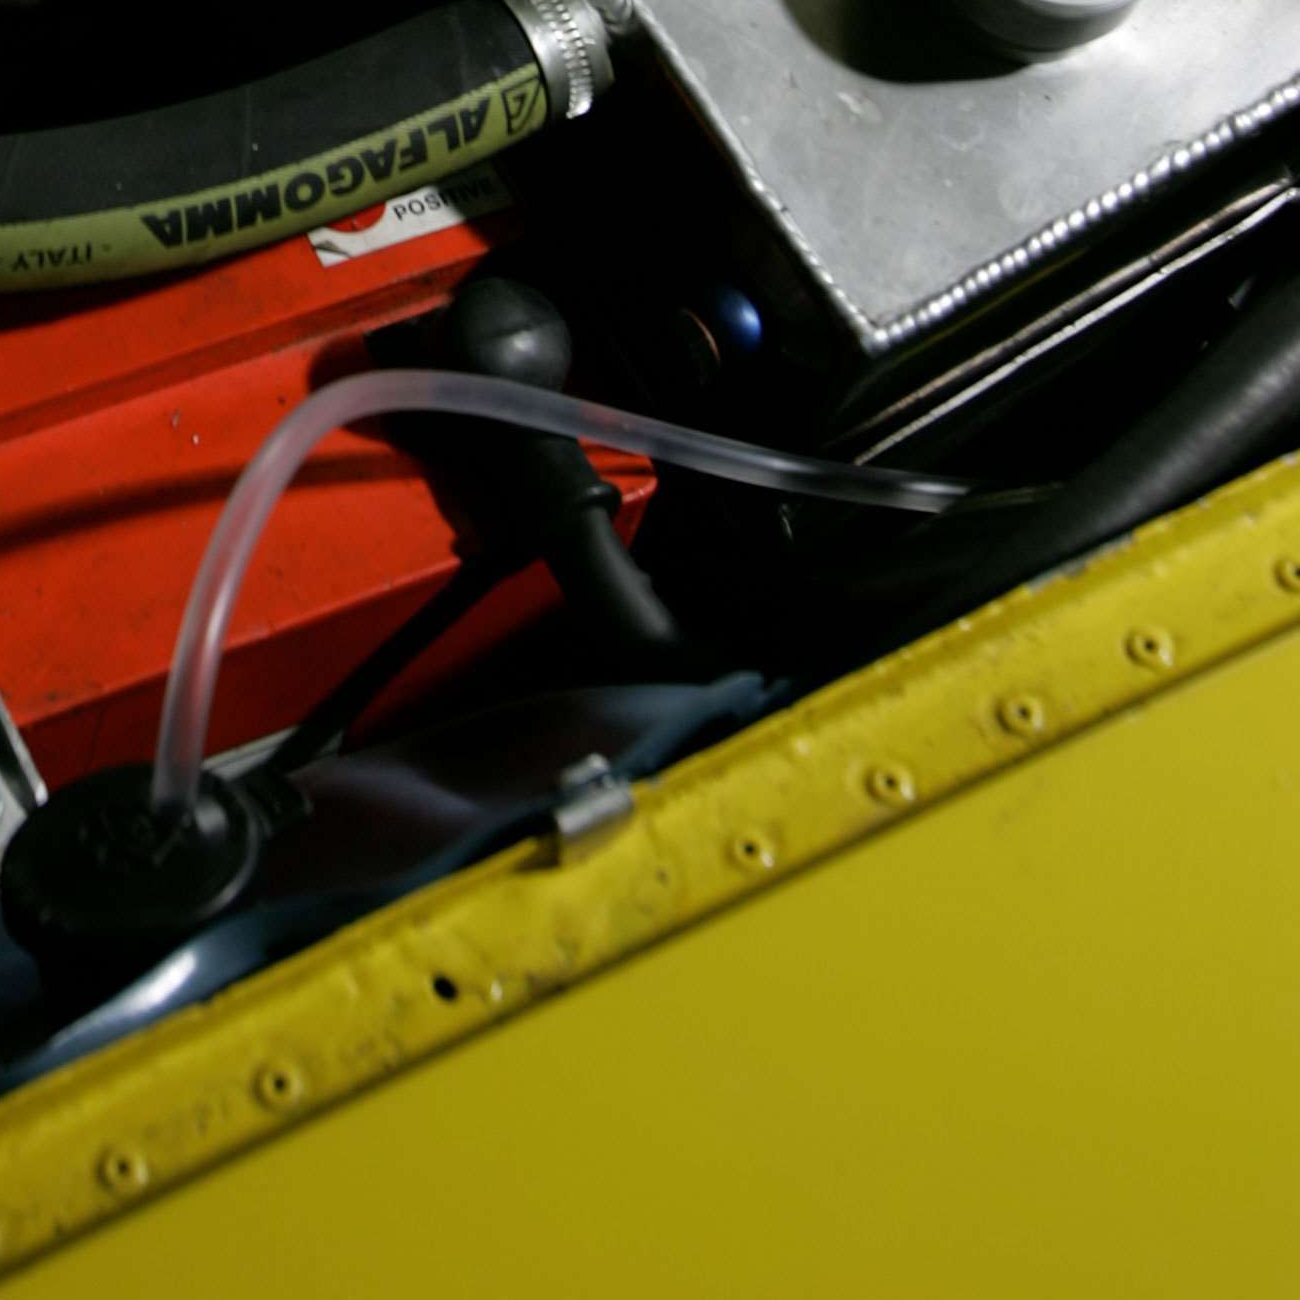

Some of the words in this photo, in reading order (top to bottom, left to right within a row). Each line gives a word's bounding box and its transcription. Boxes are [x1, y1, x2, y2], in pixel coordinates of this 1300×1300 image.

[142, 95, 493, 248] ALFAGOMMA
[392, 176, 493, 222] POSITIVE
[9, 241, 94, 273] ITALY
